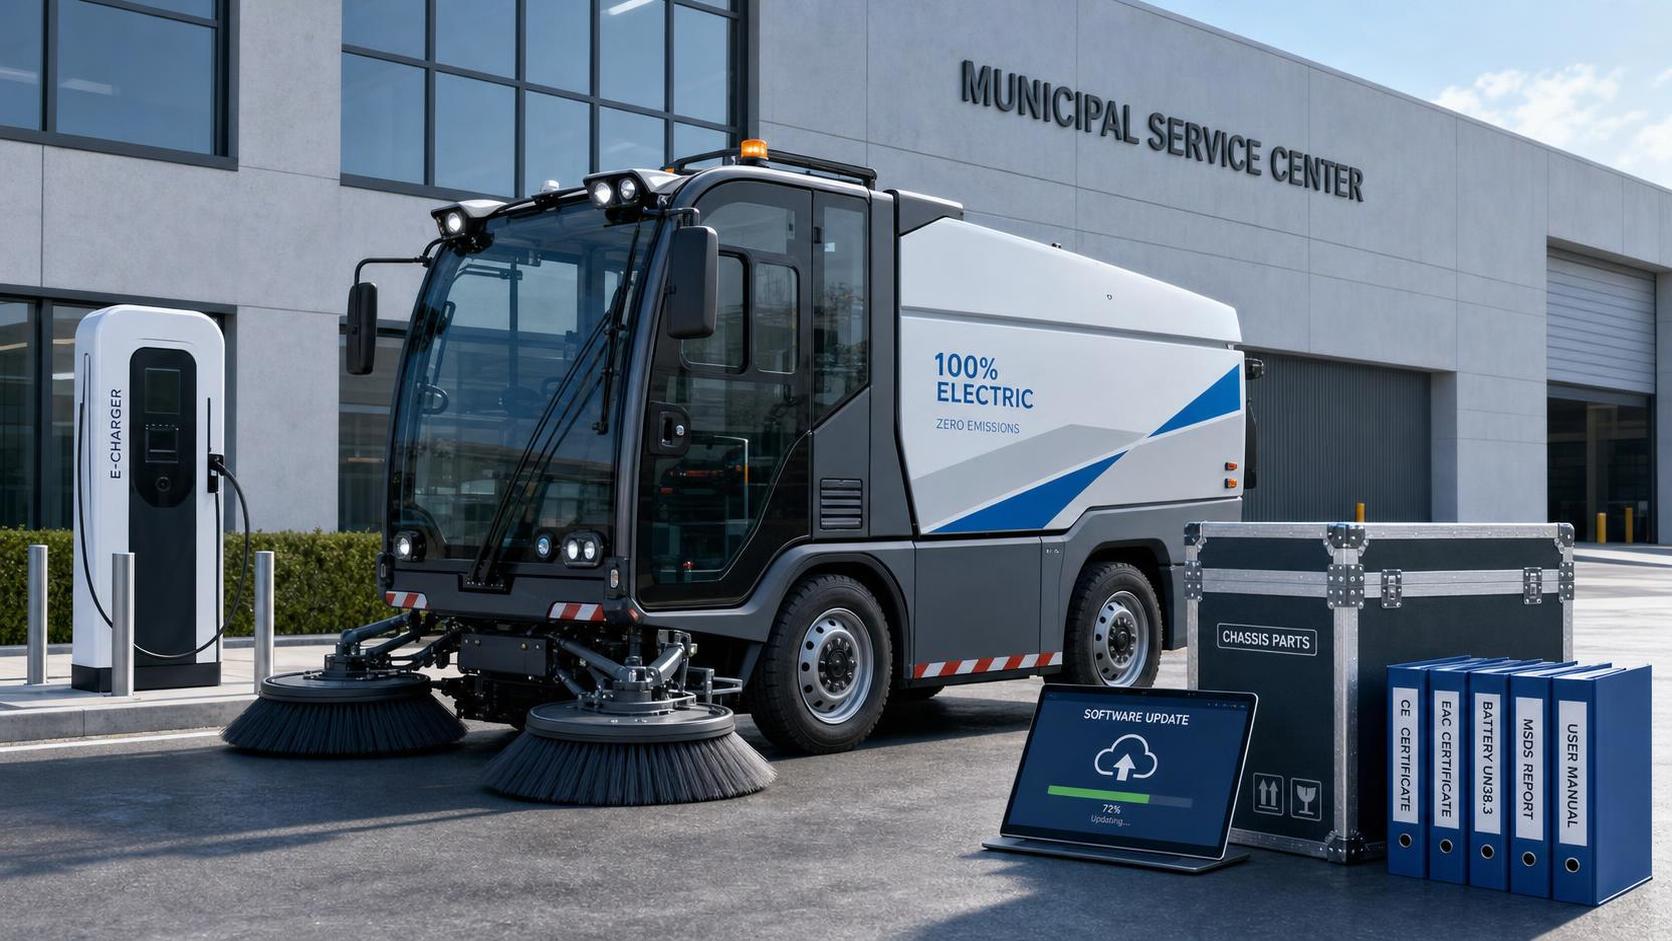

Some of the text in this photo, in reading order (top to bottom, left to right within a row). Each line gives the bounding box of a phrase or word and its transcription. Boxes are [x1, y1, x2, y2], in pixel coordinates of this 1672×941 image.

[962, 60, 1364, 202] MUNICIPAL SERVICE CENTER
[934, 352, 999, 381] 100%
[937, 381, 1034, 409] ELECTRIC
[110, 388, 122, 479] E-CHARGER
[936, 418, 1020, 434] ZERO EMISSIONS
[1222, 630, 1310, 649] CHASSIS PARTS
[1083, 708, 1190, 726] SOFTWARE UPDATE
[1400, 699, 1411, 812] CE CERTIFICATE
[1441, 700, 1452, 818] EAC CERTIFICATE
[1482, 701, 1494, 815] BATTERY UN38.3
[1522, 718, 1534, 820] MSDS REPORT
[1567, 723, 1578, 828] USER MANUAL
[1090, 815, 1130, 827] Updating...
[1102, 804, 1121, 814] 72%
